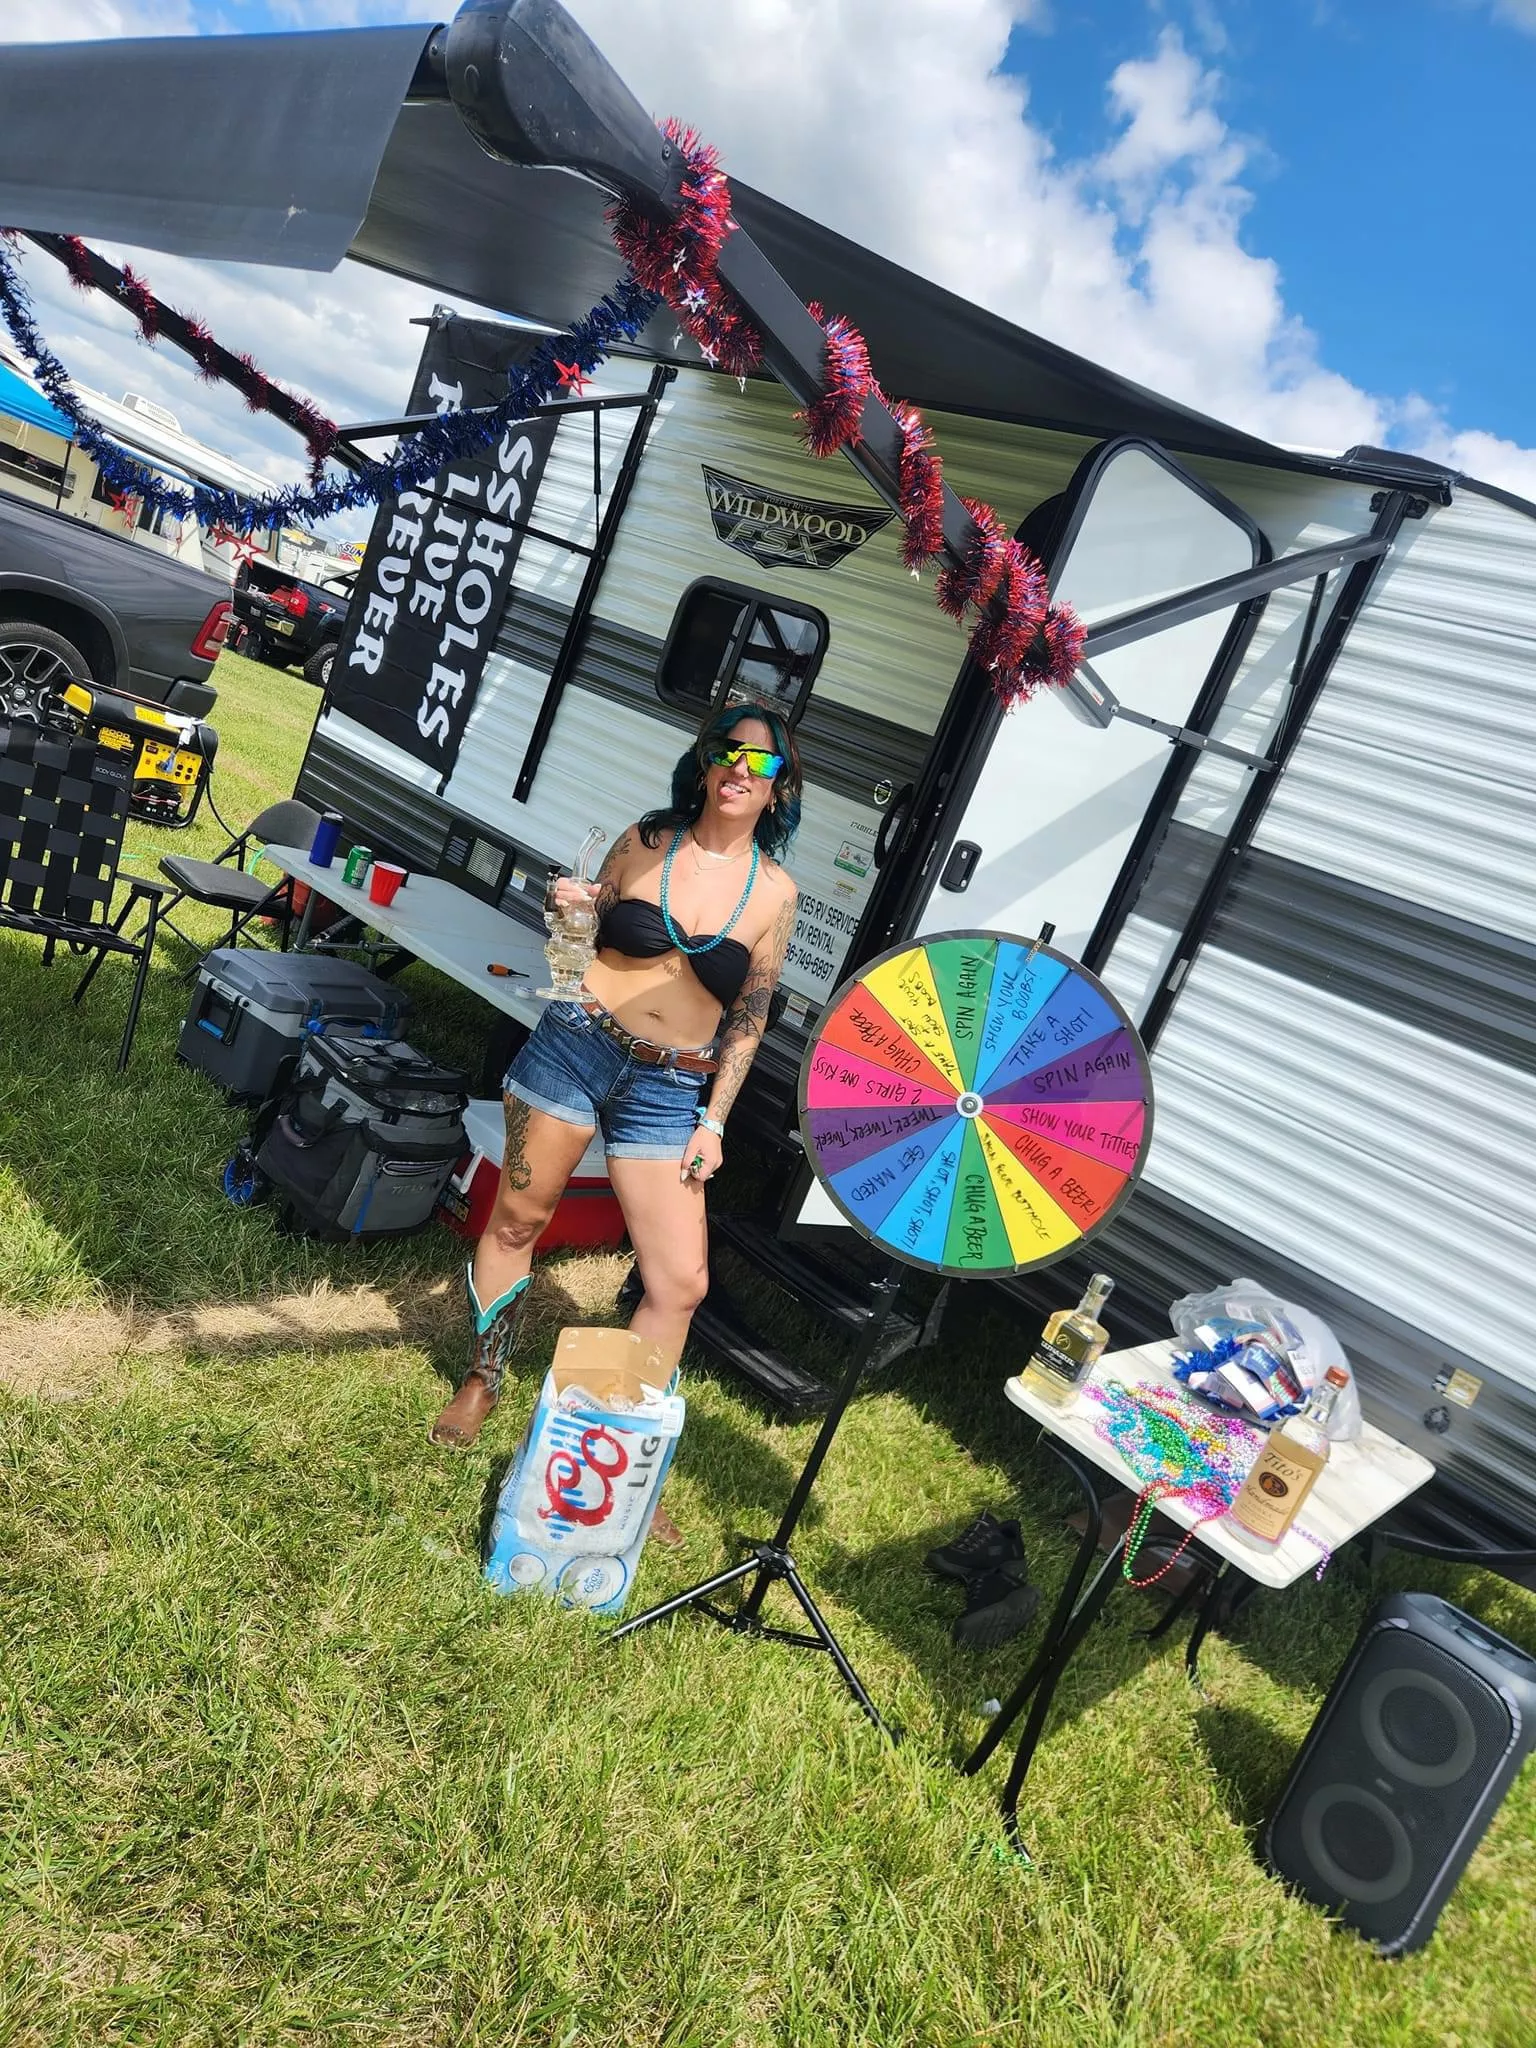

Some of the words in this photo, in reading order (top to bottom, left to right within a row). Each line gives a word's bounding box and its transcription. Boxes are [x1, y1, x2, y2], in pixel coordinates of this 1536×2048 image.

[349, 371, 463, 675] FREVER
[710, 486, 868, 545] WILDWOOD
[409, 472, 480, 624] LIVE
[726, 518, 833, 566] FSX
[417, 416, 542, 748] SSHOLES
[795, 919, 808, 943] RV
[806, 924, 834, 955] RENTAL
[814, 899, 828, 921] RV
[828, 904, 860, 937] SERVICE
[956, 955, 980, 999] AGAIN
[873, 1035, 889, 1048] A
[955, 1006, 976, 1041] SPIN
[984, 1012, 1005, 1054] SHOW
[1008, 1027, 1047, 1067] TAKE
[1046, 1014, 1061, 1029] A
[1054, 1007, 1094, 1047] SHOT!
[812, 1056, 839, 1081] KISS
[884, 1034, 922, 1074] CHUG
[1033, 1063, 1079, 1094] SPIN
[1085, 1052, 1131, 1078] AGAIN
[839, 1068, 860, 1088] ONE
[865, 1079, 907, 1103] GIRLS
[910, 1088, 923, 1105] 2
[1020, 1107, 1060, 1131] SHOW
[1064, 1119, 1096, 1143] YOUR
[900, 1144, 925, 1173] GET
[1014, 1134, 1052, 1173] CHUG
[1050, 1166, 1063, 1180] A
[1059, 1177, 1102, 1221] BEER!
[851, 1167, 897, 1203] NAKED
[964, 1174, 986, 1214] CHUG
[969, 1216, 982, 1226] A
[536, 1423, 635, 1527] Co
[627, 1435, 661, 1488] LIG
[1263, 1451, 1305, 1482] Tito's
[583, 1567, 601, 1595] Coors
